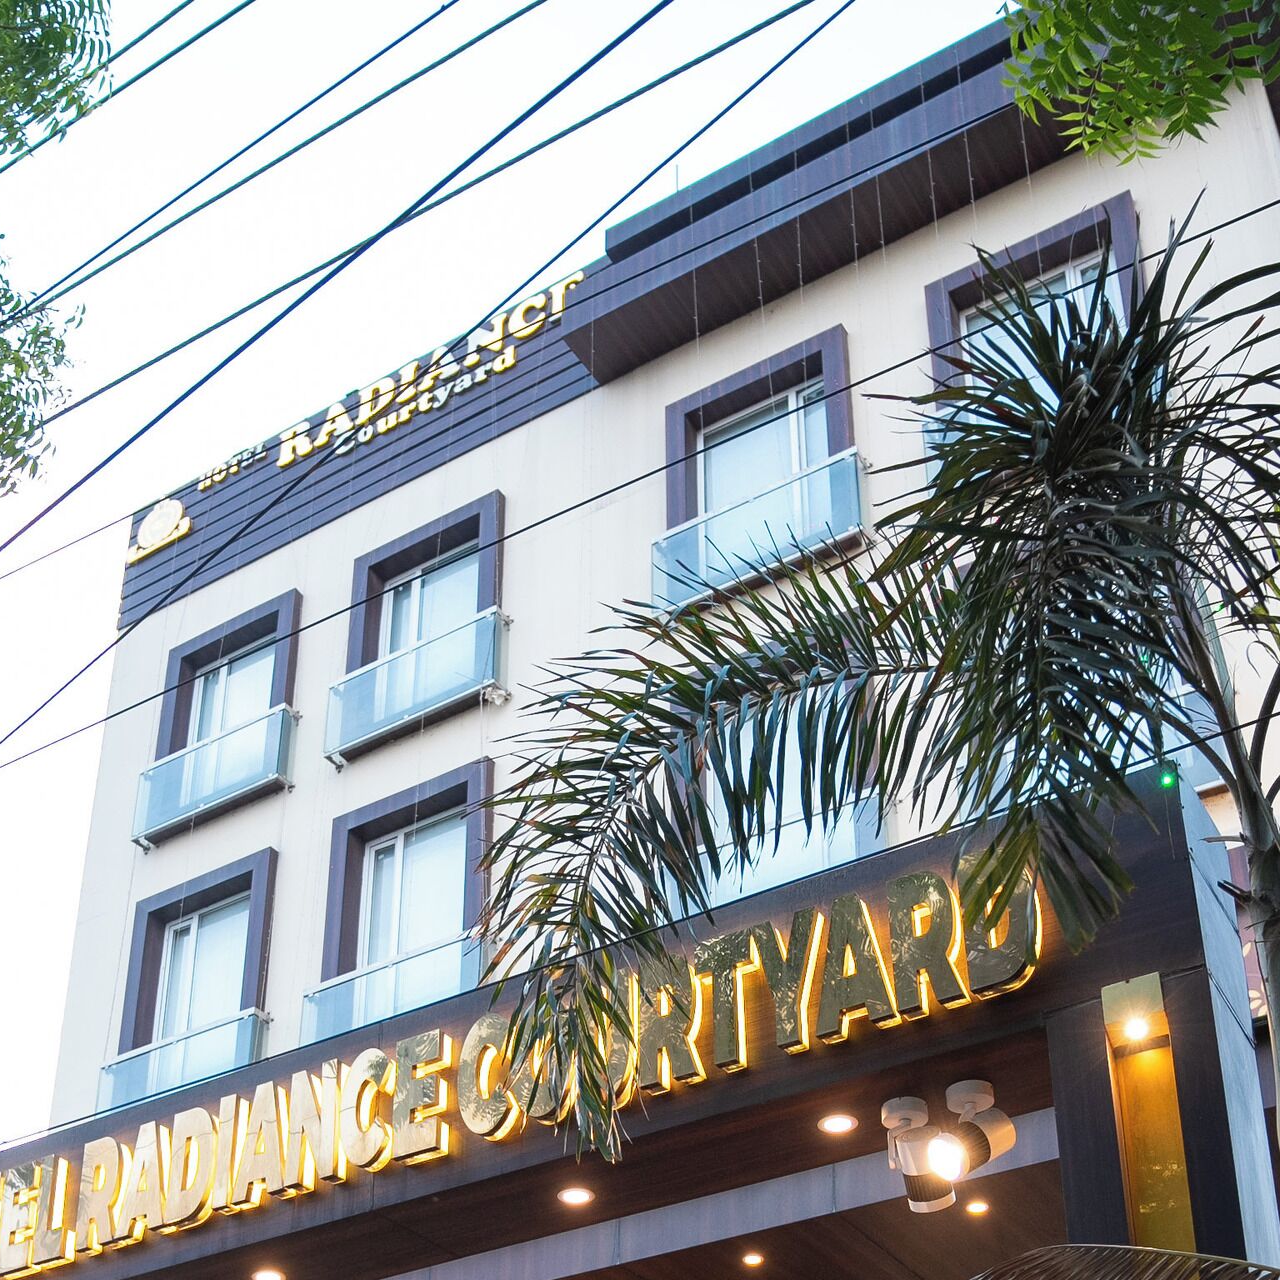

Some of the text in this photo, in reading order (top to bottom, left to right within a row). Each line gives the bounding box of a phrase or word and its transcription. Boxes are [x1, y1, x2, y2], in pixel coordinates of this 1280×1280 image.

[333, 345, 517, 455] Courtyard
[197, 442, 268, 492] HOTEL
[76, 1028, 453, 1257] RADIANCE
